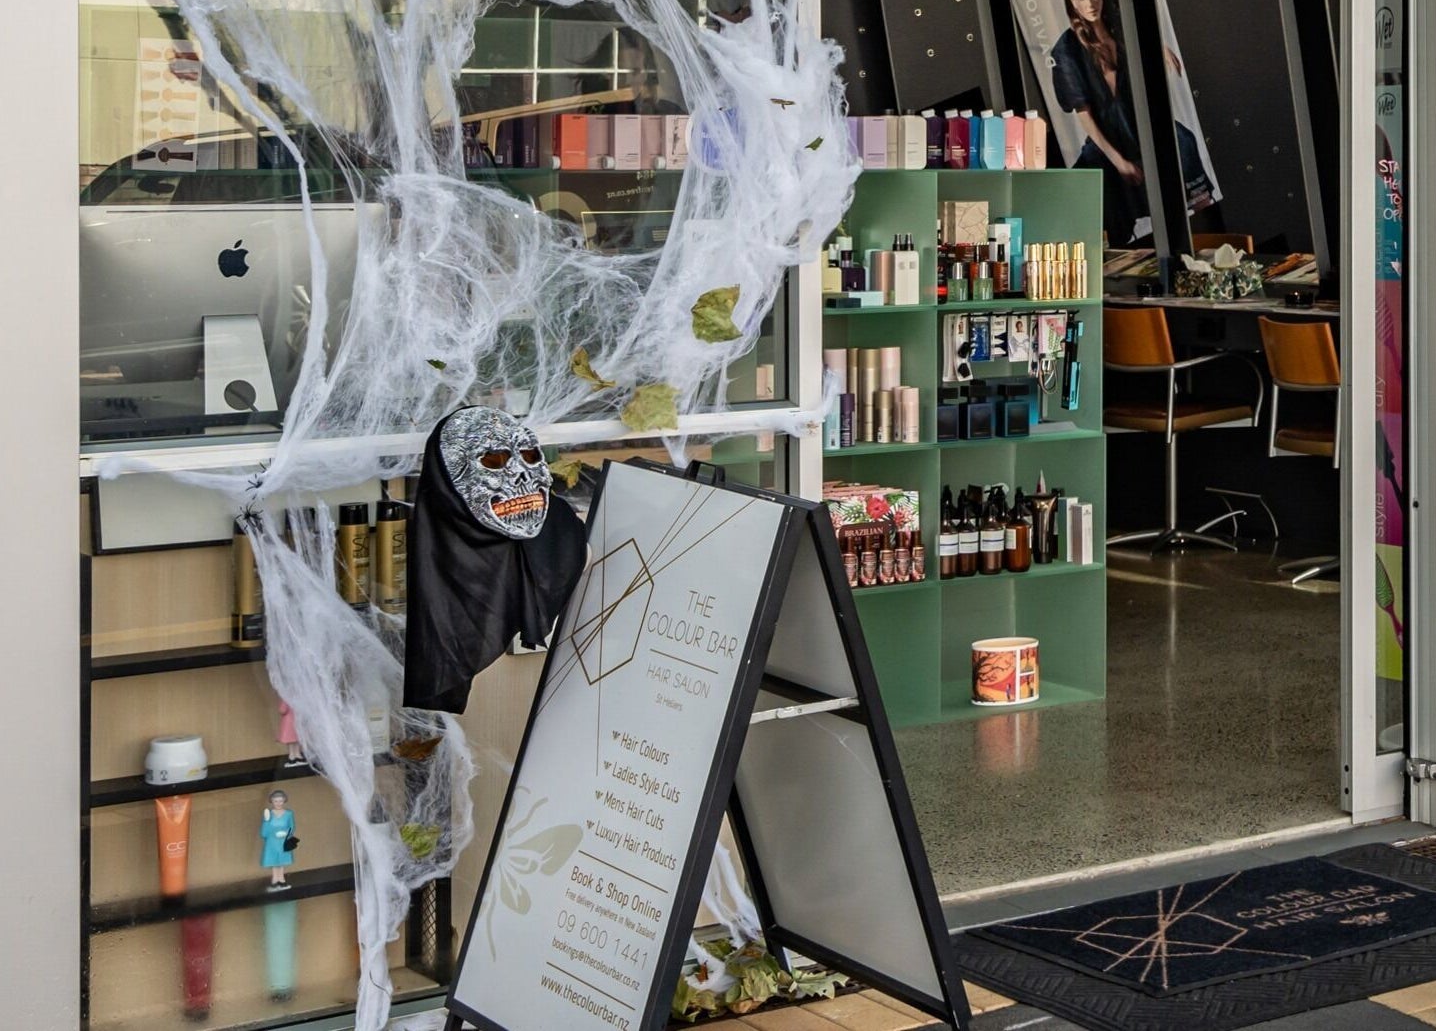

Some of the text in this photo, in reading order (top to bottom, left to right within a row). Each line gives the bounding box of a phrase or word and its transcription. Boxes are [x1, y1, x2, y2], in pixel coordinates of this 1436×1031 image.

[844, 526, 884, 538] BRAZILIAN
[687, 590, 716, 618] THE
[646, 611, 738, 659] COLOUR BAR
[646, 663, 712, 699] HAIR SALON
[620, 732, 670, 766] Hair Colours
[612, 761, 681, 804] Ladies Style Cuts
[603, 790, 665, 831] Mens Hair Cuts
[595, 820, 677, 871] Luxury Hair Products
[565, 887, 577, 902] Free
[576, 892, 595, 914] delivery
[595, 905, 618, 922] anywhere
[635, 922, 657, 941] Zealand
[570, 866, 662, 923] Book & Shop Online
[1236, 895, 1325, 919] COLOUR
[1253, 890, 1416, 931] HAIR SALON
[1265, 888, 1316, 902] THE
[557, 909, 648, 971] 09 600 1441
[551, 935, 641, 992] bookings@thecolourbar.co.nz
[540, 973, 631, 1031] www.thecolourbar.nz
